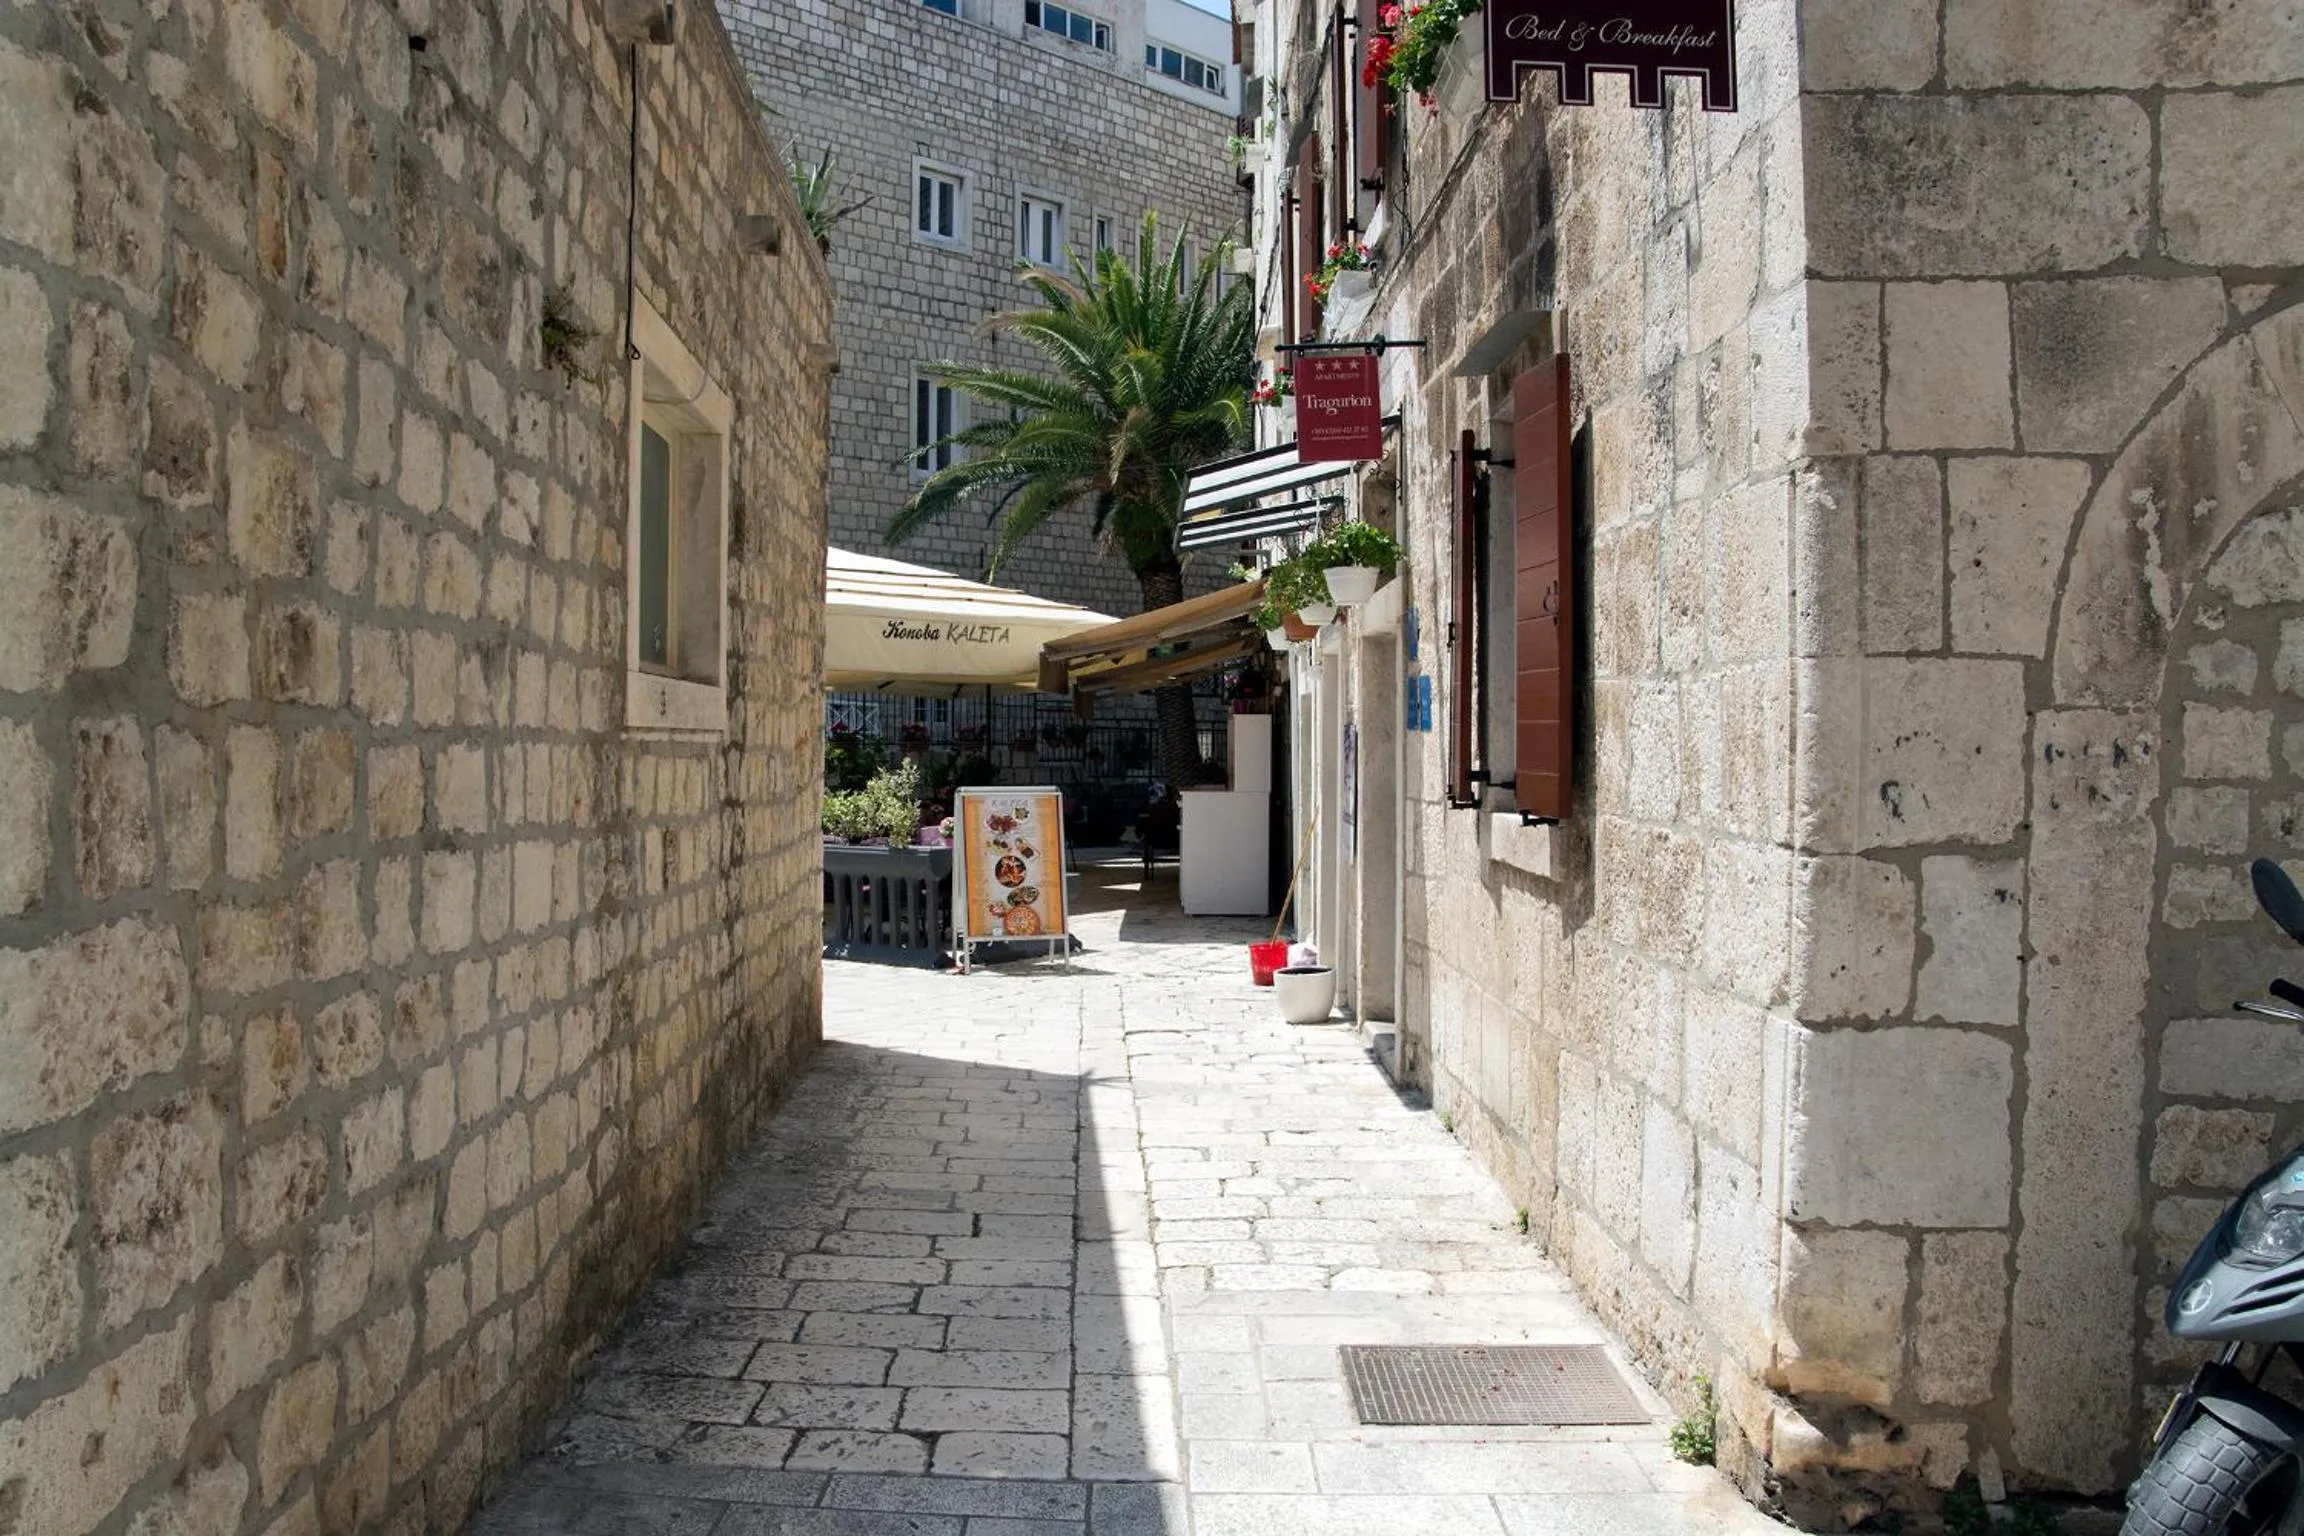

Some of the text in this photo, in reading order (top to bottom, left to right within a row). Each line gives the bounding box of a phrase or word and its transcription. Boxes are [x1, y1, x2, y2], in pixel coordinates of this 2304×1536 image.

[1505, 14, 1718, 56] Bed & Breakfast
[1302, 394, 1373, 416] Tragurion
[882, 619, 1010, 645] Konoba KALETA
